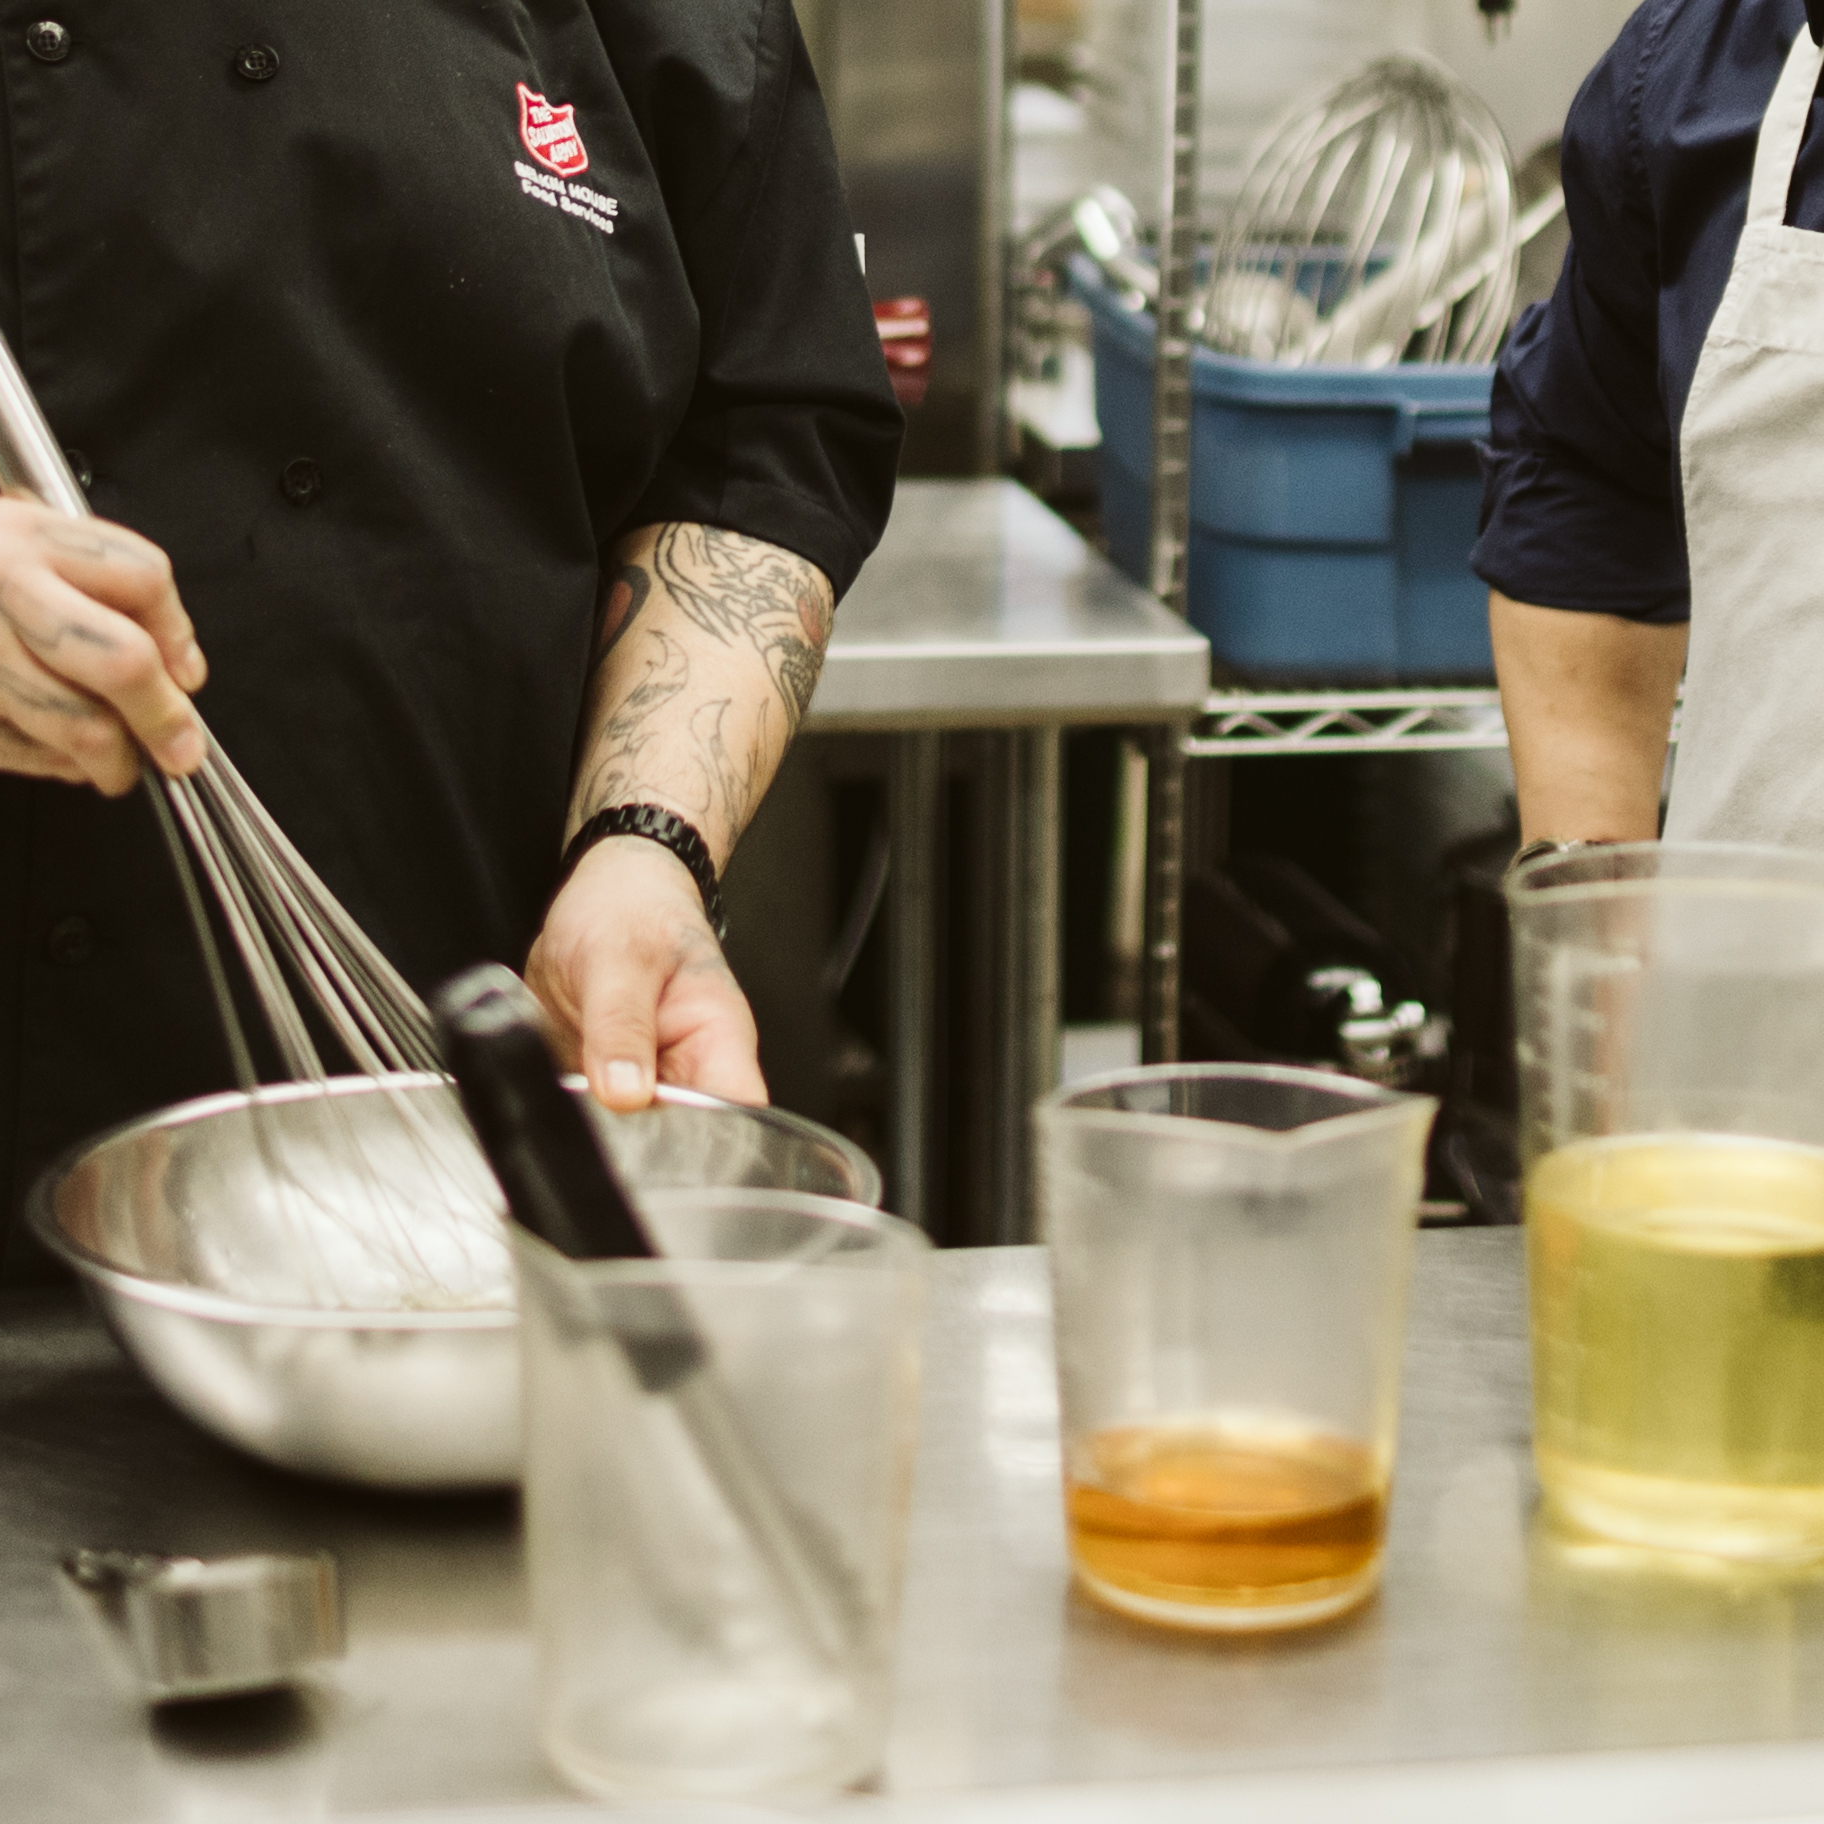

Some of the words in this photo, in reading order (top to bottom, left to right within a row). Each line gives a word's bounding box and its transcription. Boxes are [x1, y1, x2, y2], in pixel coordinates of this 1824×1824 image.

[521, 178, 558, 208] Food
[560, 195, 614, 234] Services
[568, 182, 619, 216] HOUSE
